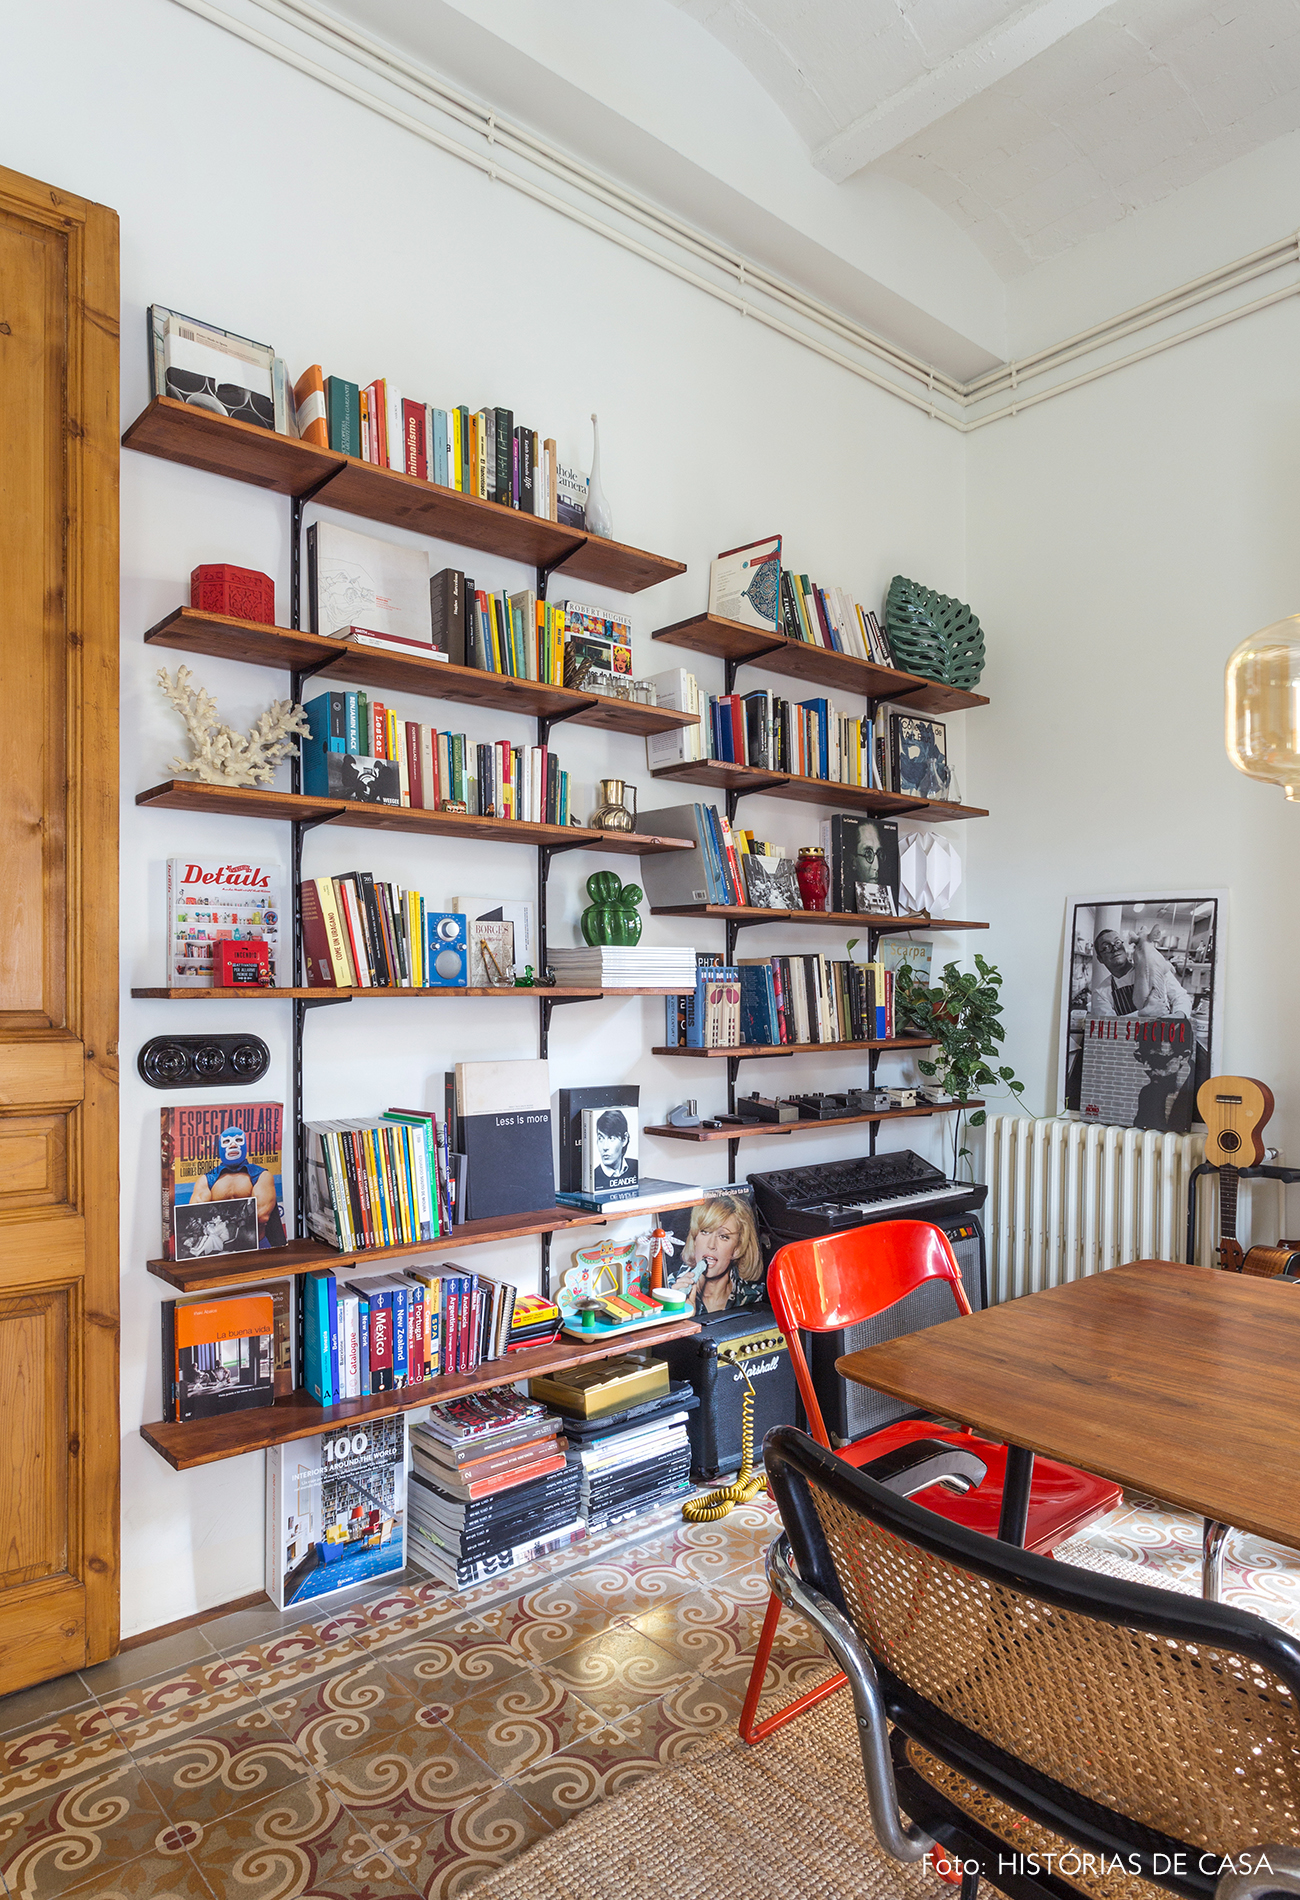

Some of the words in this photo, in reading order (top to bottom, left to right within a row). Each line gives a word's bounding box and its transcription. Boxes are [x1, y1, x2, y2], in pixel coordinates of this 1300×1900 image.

[408, 417, 417, 477] inimalismo
[523, 476, 533, 490] life
[569, 603, 601, 617] ROBERT
[602, 611, 632, 626] HUGHES
[180, 864, 271, 888] Details
[327, 912, 339, 938] URAGANO
[334, 947, 343, 961] COME
[697, 957, 719, 967] PHIC
[890, 943, 926, 960] Scarpa
[1089, 1020, 1118, 1040] PHIL
[1126, 1021, 1185, 1043] SPECTOR
[180, 1108, 272, 1137] ESPECTACULAR
[495, 1116, 515, 1127] Less
[516, 1115, 524, 1125] is
[526, 1114, 549, 1124] more
[180, 1134, 220, 1162] LUCHA
[248, 1132, 278, 1157] LIBRE
[414, 1305, 423, 1341] Portugal
[448, 1296, 456, 1333] Argentina
[216, 1331, 227, 1340] La
[228, 1327, 253, 1338] buena
[254, 1325, 271, 1334] vida
[375, 1312, 387, 1356] México
[397, 1328, 405, 1361] Zealand
[350, 1332, 358, 1375] Catalogne
[733, 1356, 780, 1382] Marshall
[447, 1402, 491, 1427] ROCK
[323, 1433, 368, 1462] 100
[291, 1466, 328, 1482] INTERIORS
[328, 1458, 359, 1474] AROUND
[360, 1453, 372, 1463] THE
[373, 1447, 397, 1459] WORLD
